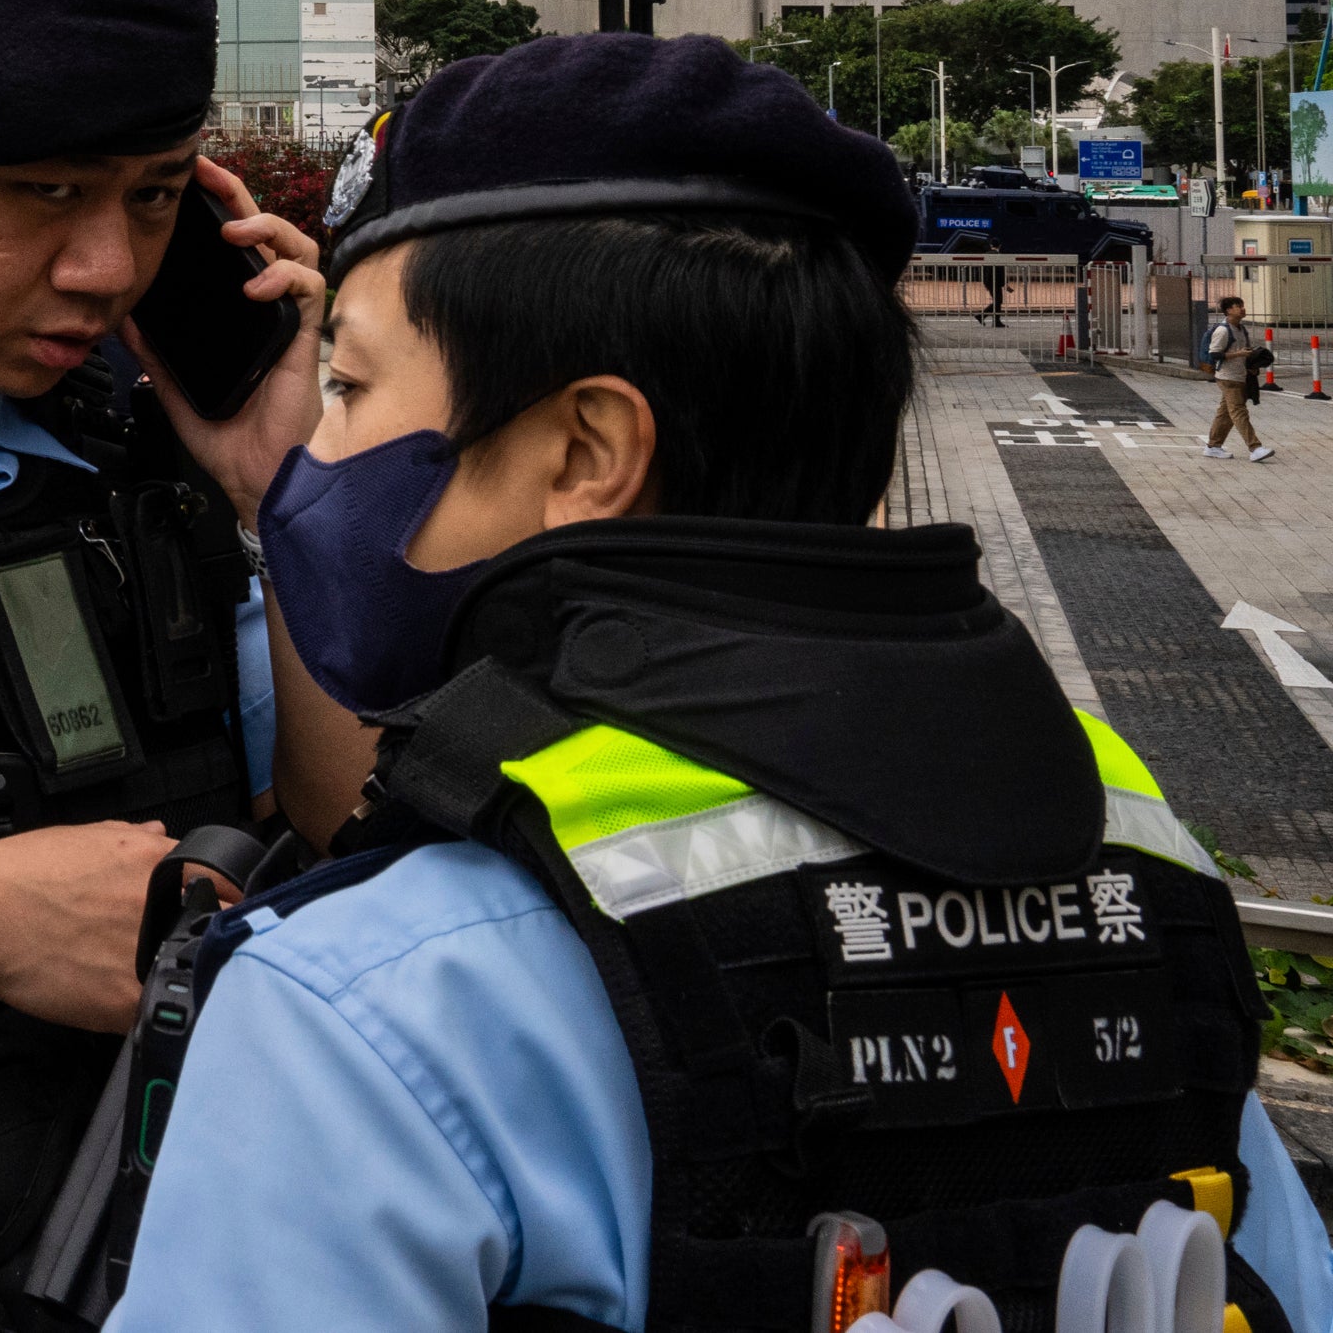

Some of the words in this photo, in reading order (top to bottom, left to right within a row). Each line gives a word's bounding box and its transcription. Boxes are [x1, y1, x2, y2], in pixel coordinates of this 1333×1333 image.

[948, 219, 980, 227] POLICE
[1017, 418, 1168, 430] OUT
[47, 703, 103, 737] 60862
[1002, 1026, 1018, 1069] F
[1092, 1016, 1142, 1063] 5/2
